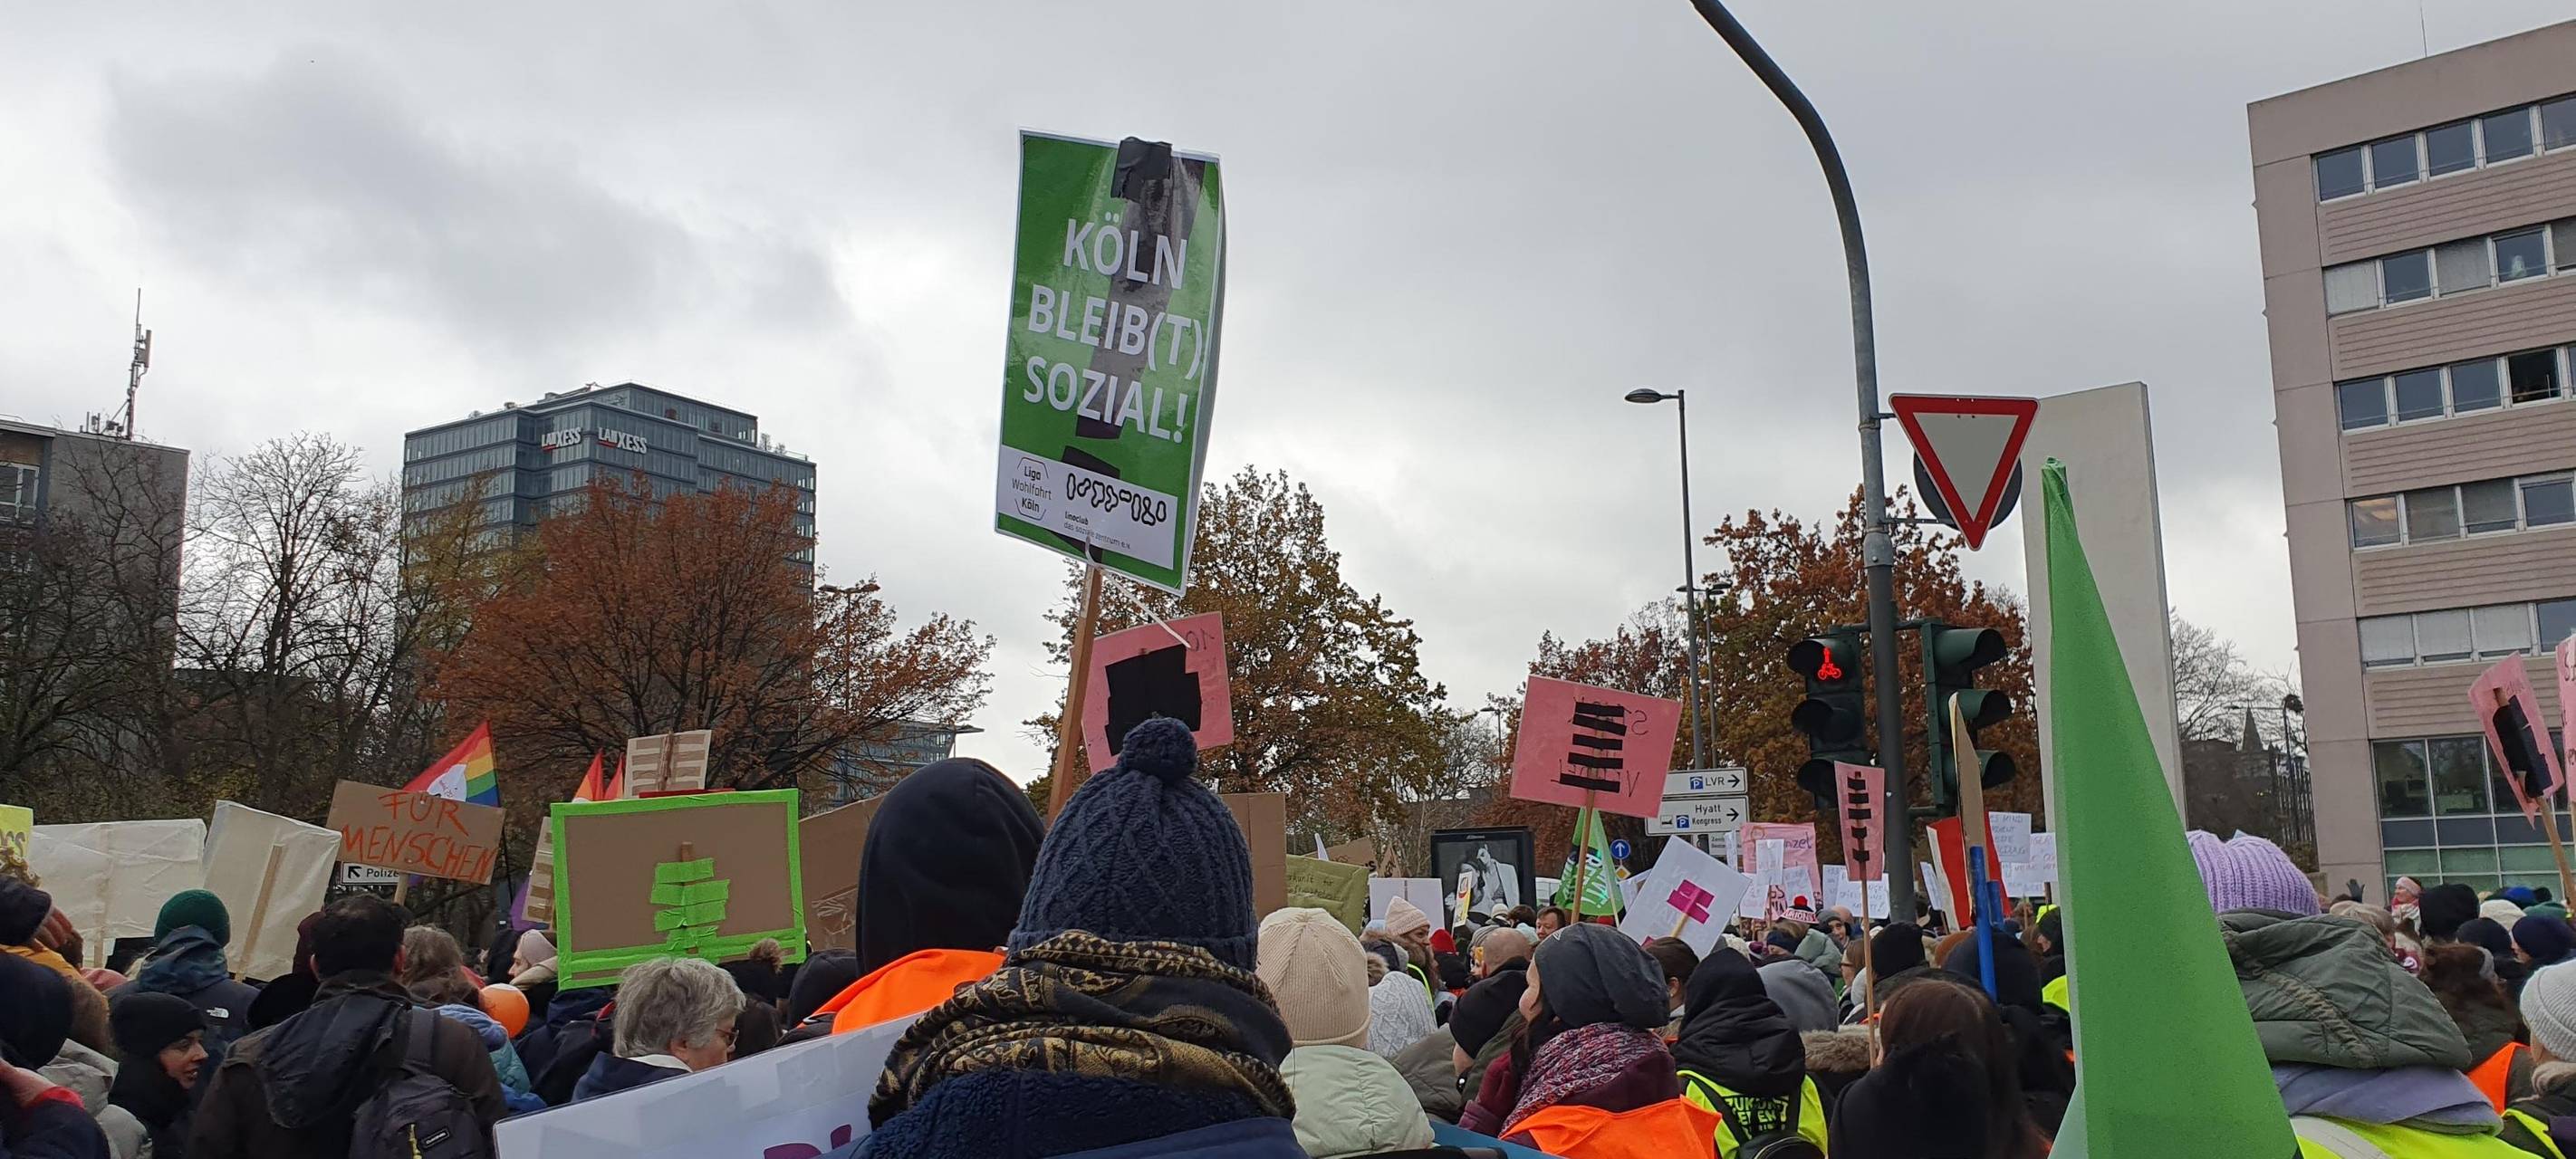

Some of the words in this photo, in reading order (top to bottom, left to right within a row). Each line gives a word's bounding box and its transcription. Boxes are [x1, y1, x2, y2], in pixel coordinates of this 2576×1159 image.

[1063, 211, 1187, 290] KÖLN
[1028, 284, 1203, 380] BLEIB(T)
[1024, 356, 1188, 444] SOZIAL!
[542, 427, 582, 447] LANXESS
[598, 427, 648, 454] LANXESS
[1024, 465, 1042, 482] Liga
[1012, 477, 1053, 501] Wohlfahrt
[1022, 497, 1041, 513] Köln
[1095, 532, 1121, 546] zentrum
[1706, 777, 1725, 786] LVR
[379, 791, 469, 837] FÜR
[1695, 804, 1721, 815] Hyatt
[1692, 817, 1722, 827] Kongress
[341, 823, 499, 882] MENSCHEN
